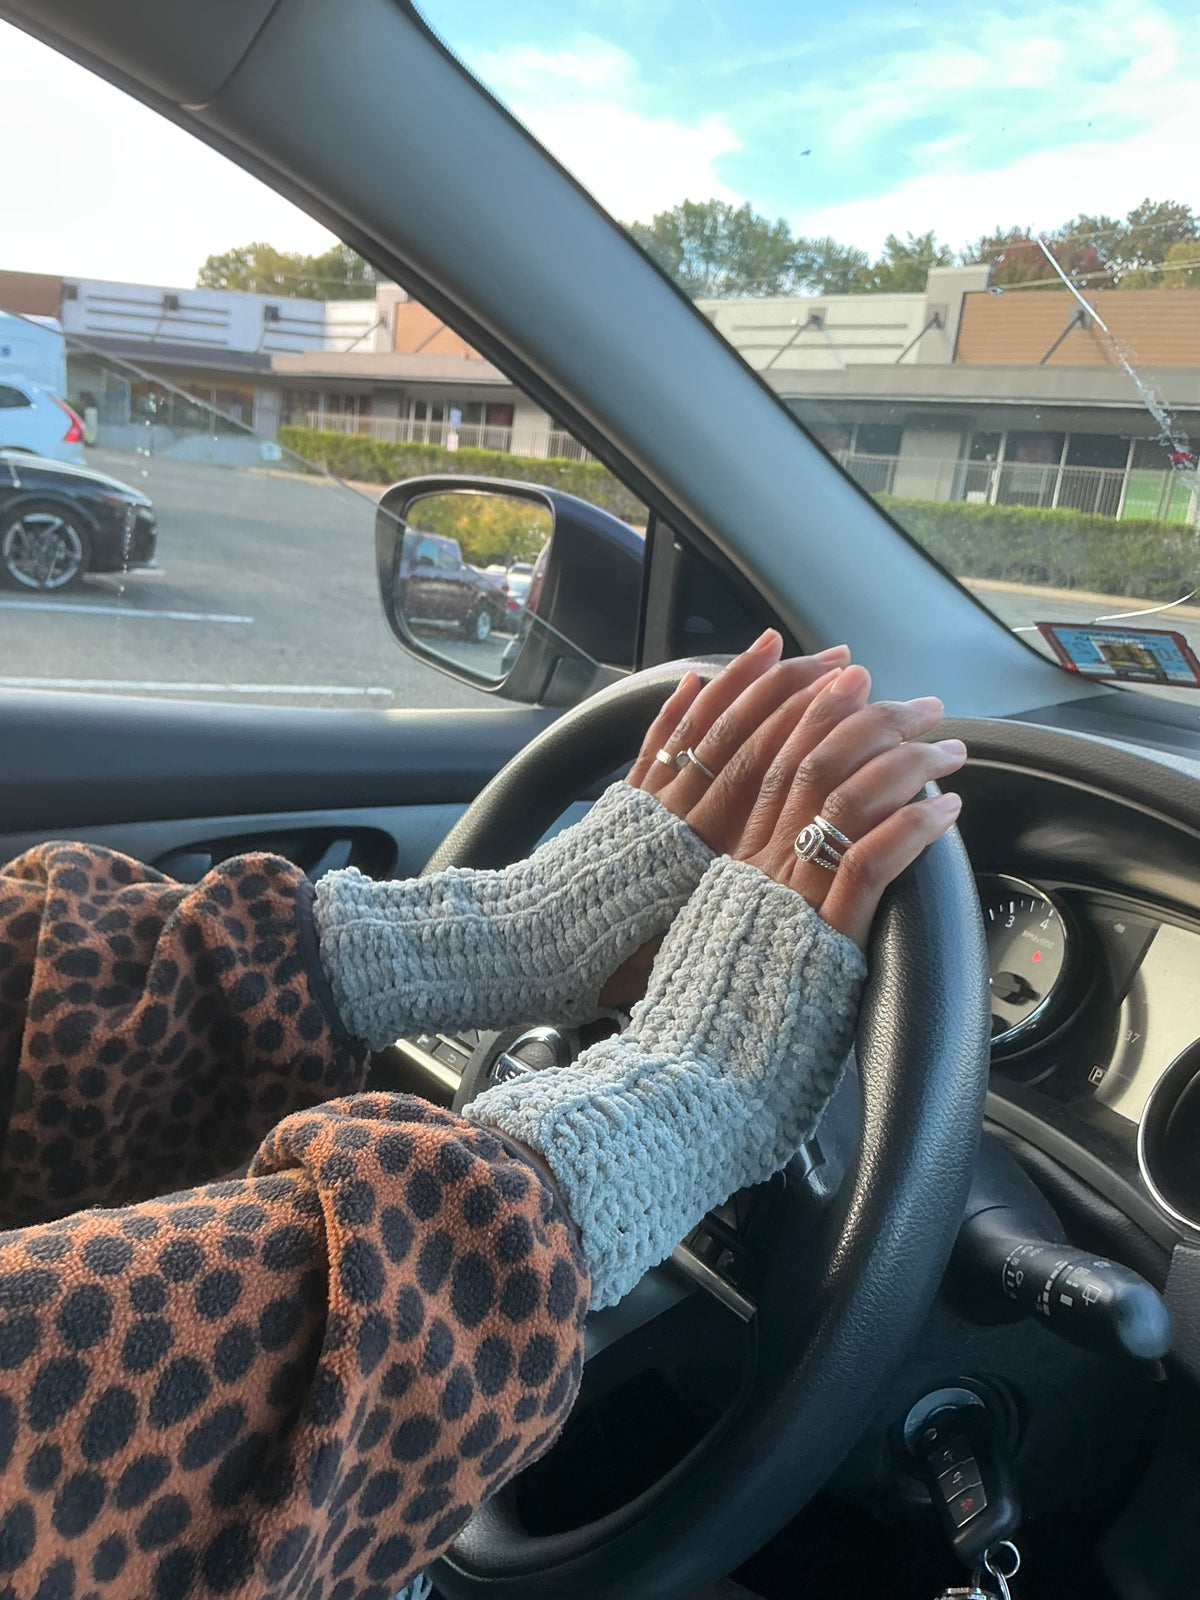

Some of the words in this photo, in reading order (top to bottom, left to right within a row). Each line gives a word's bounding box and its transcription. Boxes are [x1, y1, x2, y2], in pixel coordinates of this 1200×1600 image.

[1005, 915, 1016, 928] 3
[1039, 918, 1050, 932] 4
[1092, 1068, 1103, 1081] P
